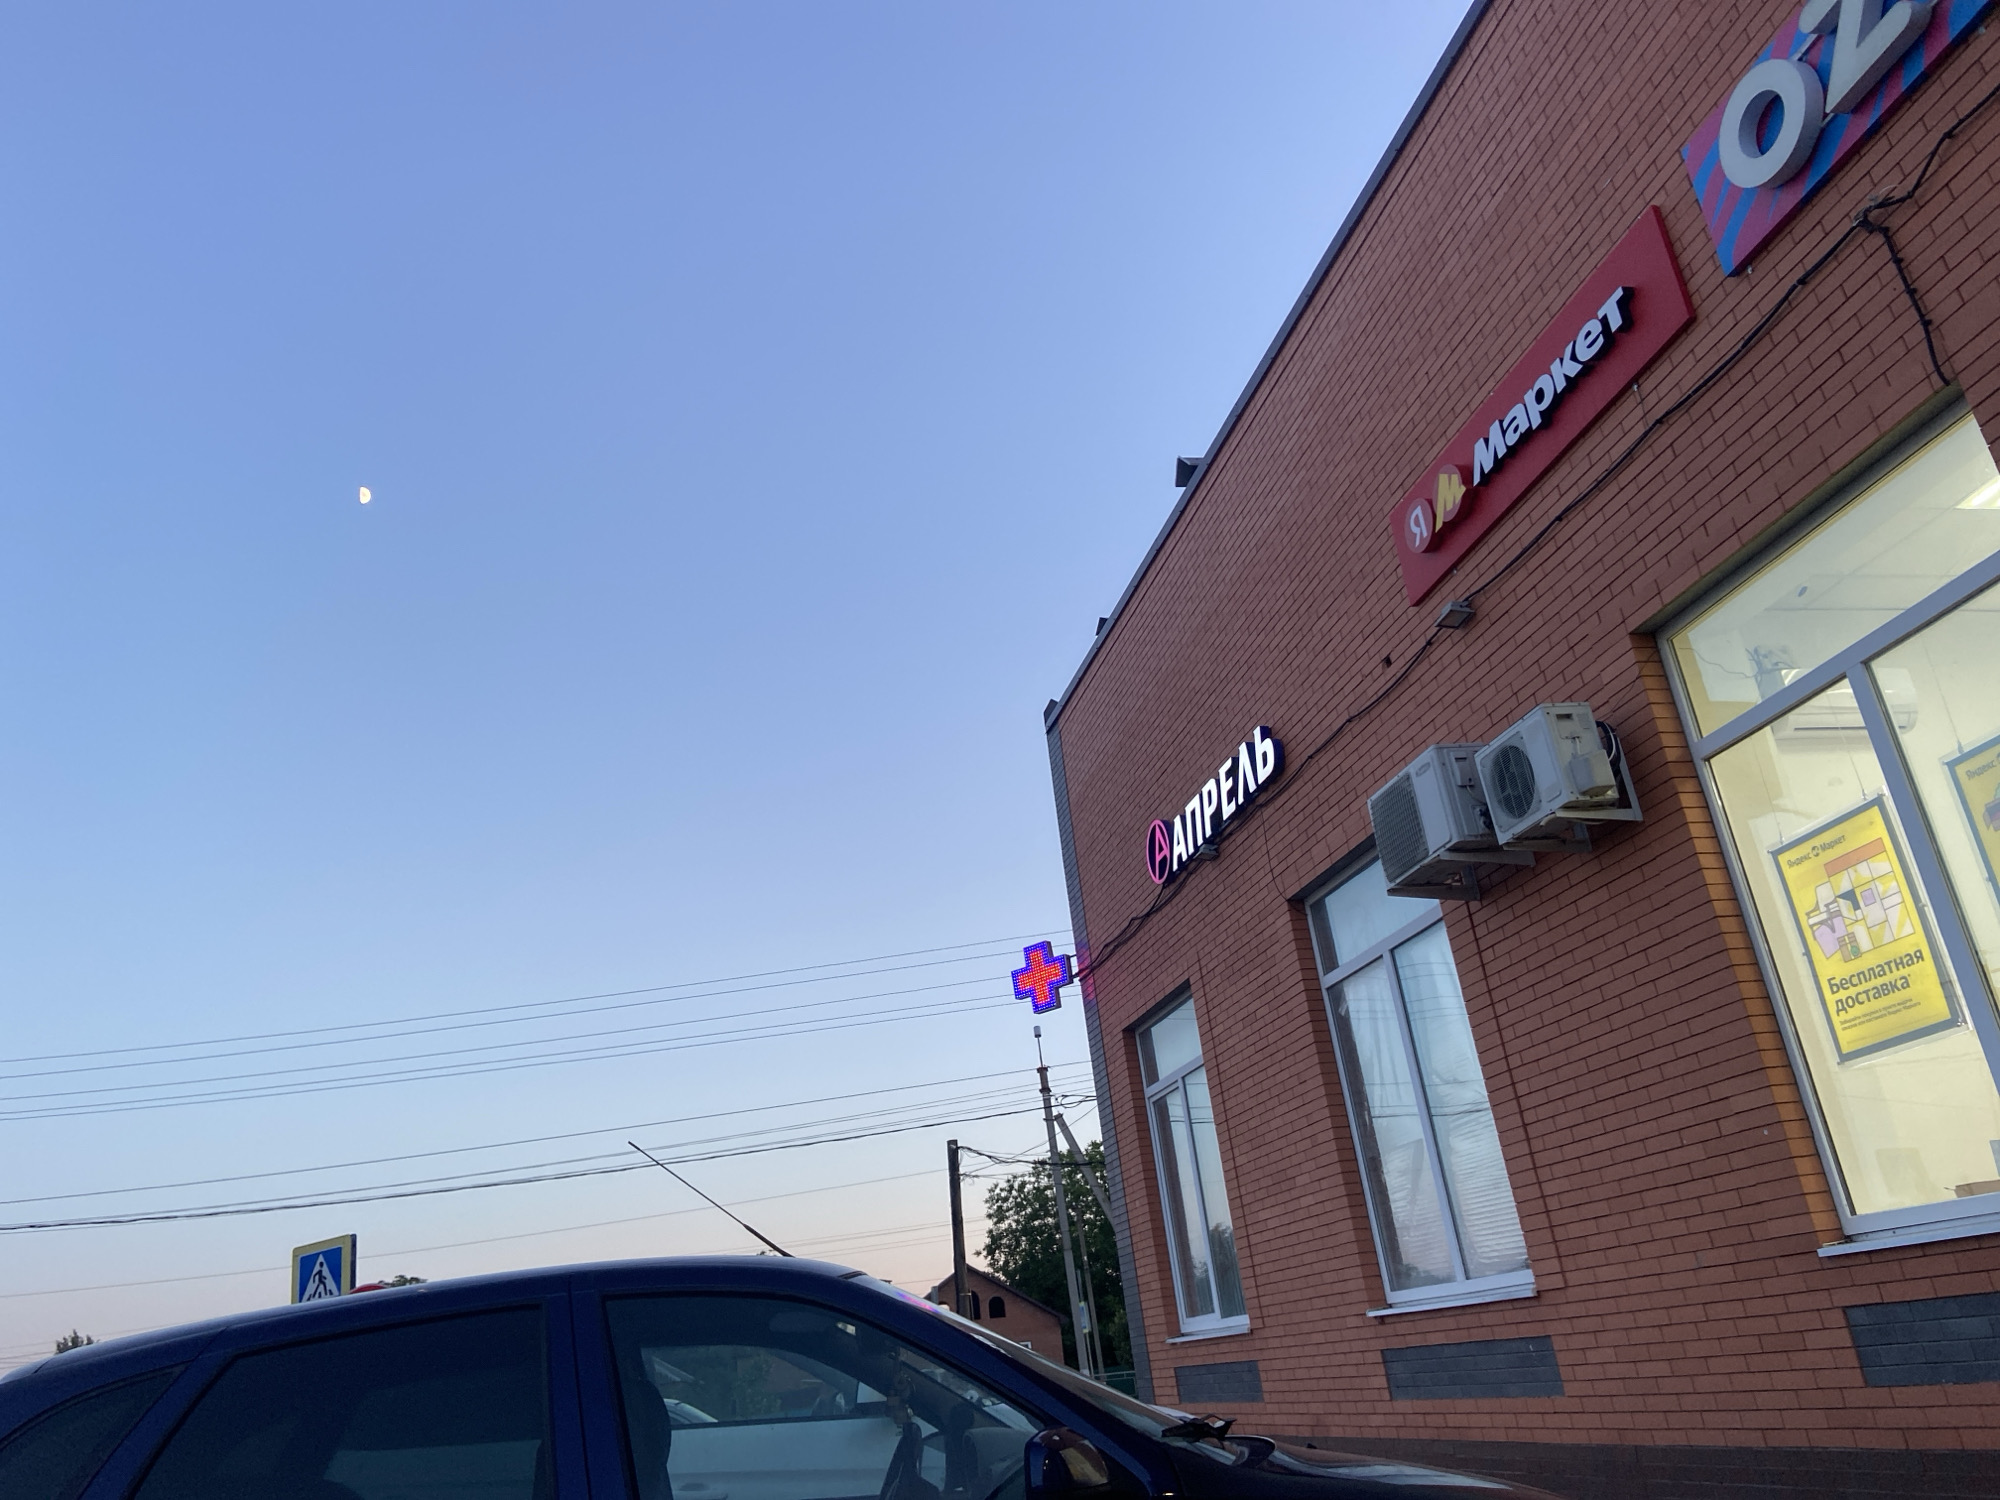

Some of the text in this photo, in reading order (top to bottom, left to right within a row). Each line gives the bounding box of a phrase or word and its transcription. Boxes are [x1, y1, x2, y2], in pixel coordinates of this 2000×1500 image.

[1408, 502, 1430, 549] Я
[1473, 286, 1627, 487] Маркет
[1965, 760, 1997, 780] Яндекс
[1172, 725, 1276, 872] АПРЕЛЬ
[1787, 835, 1846, 869] Яндекс Маркет
[1827, 948, 1925, 995] Бесплатная
